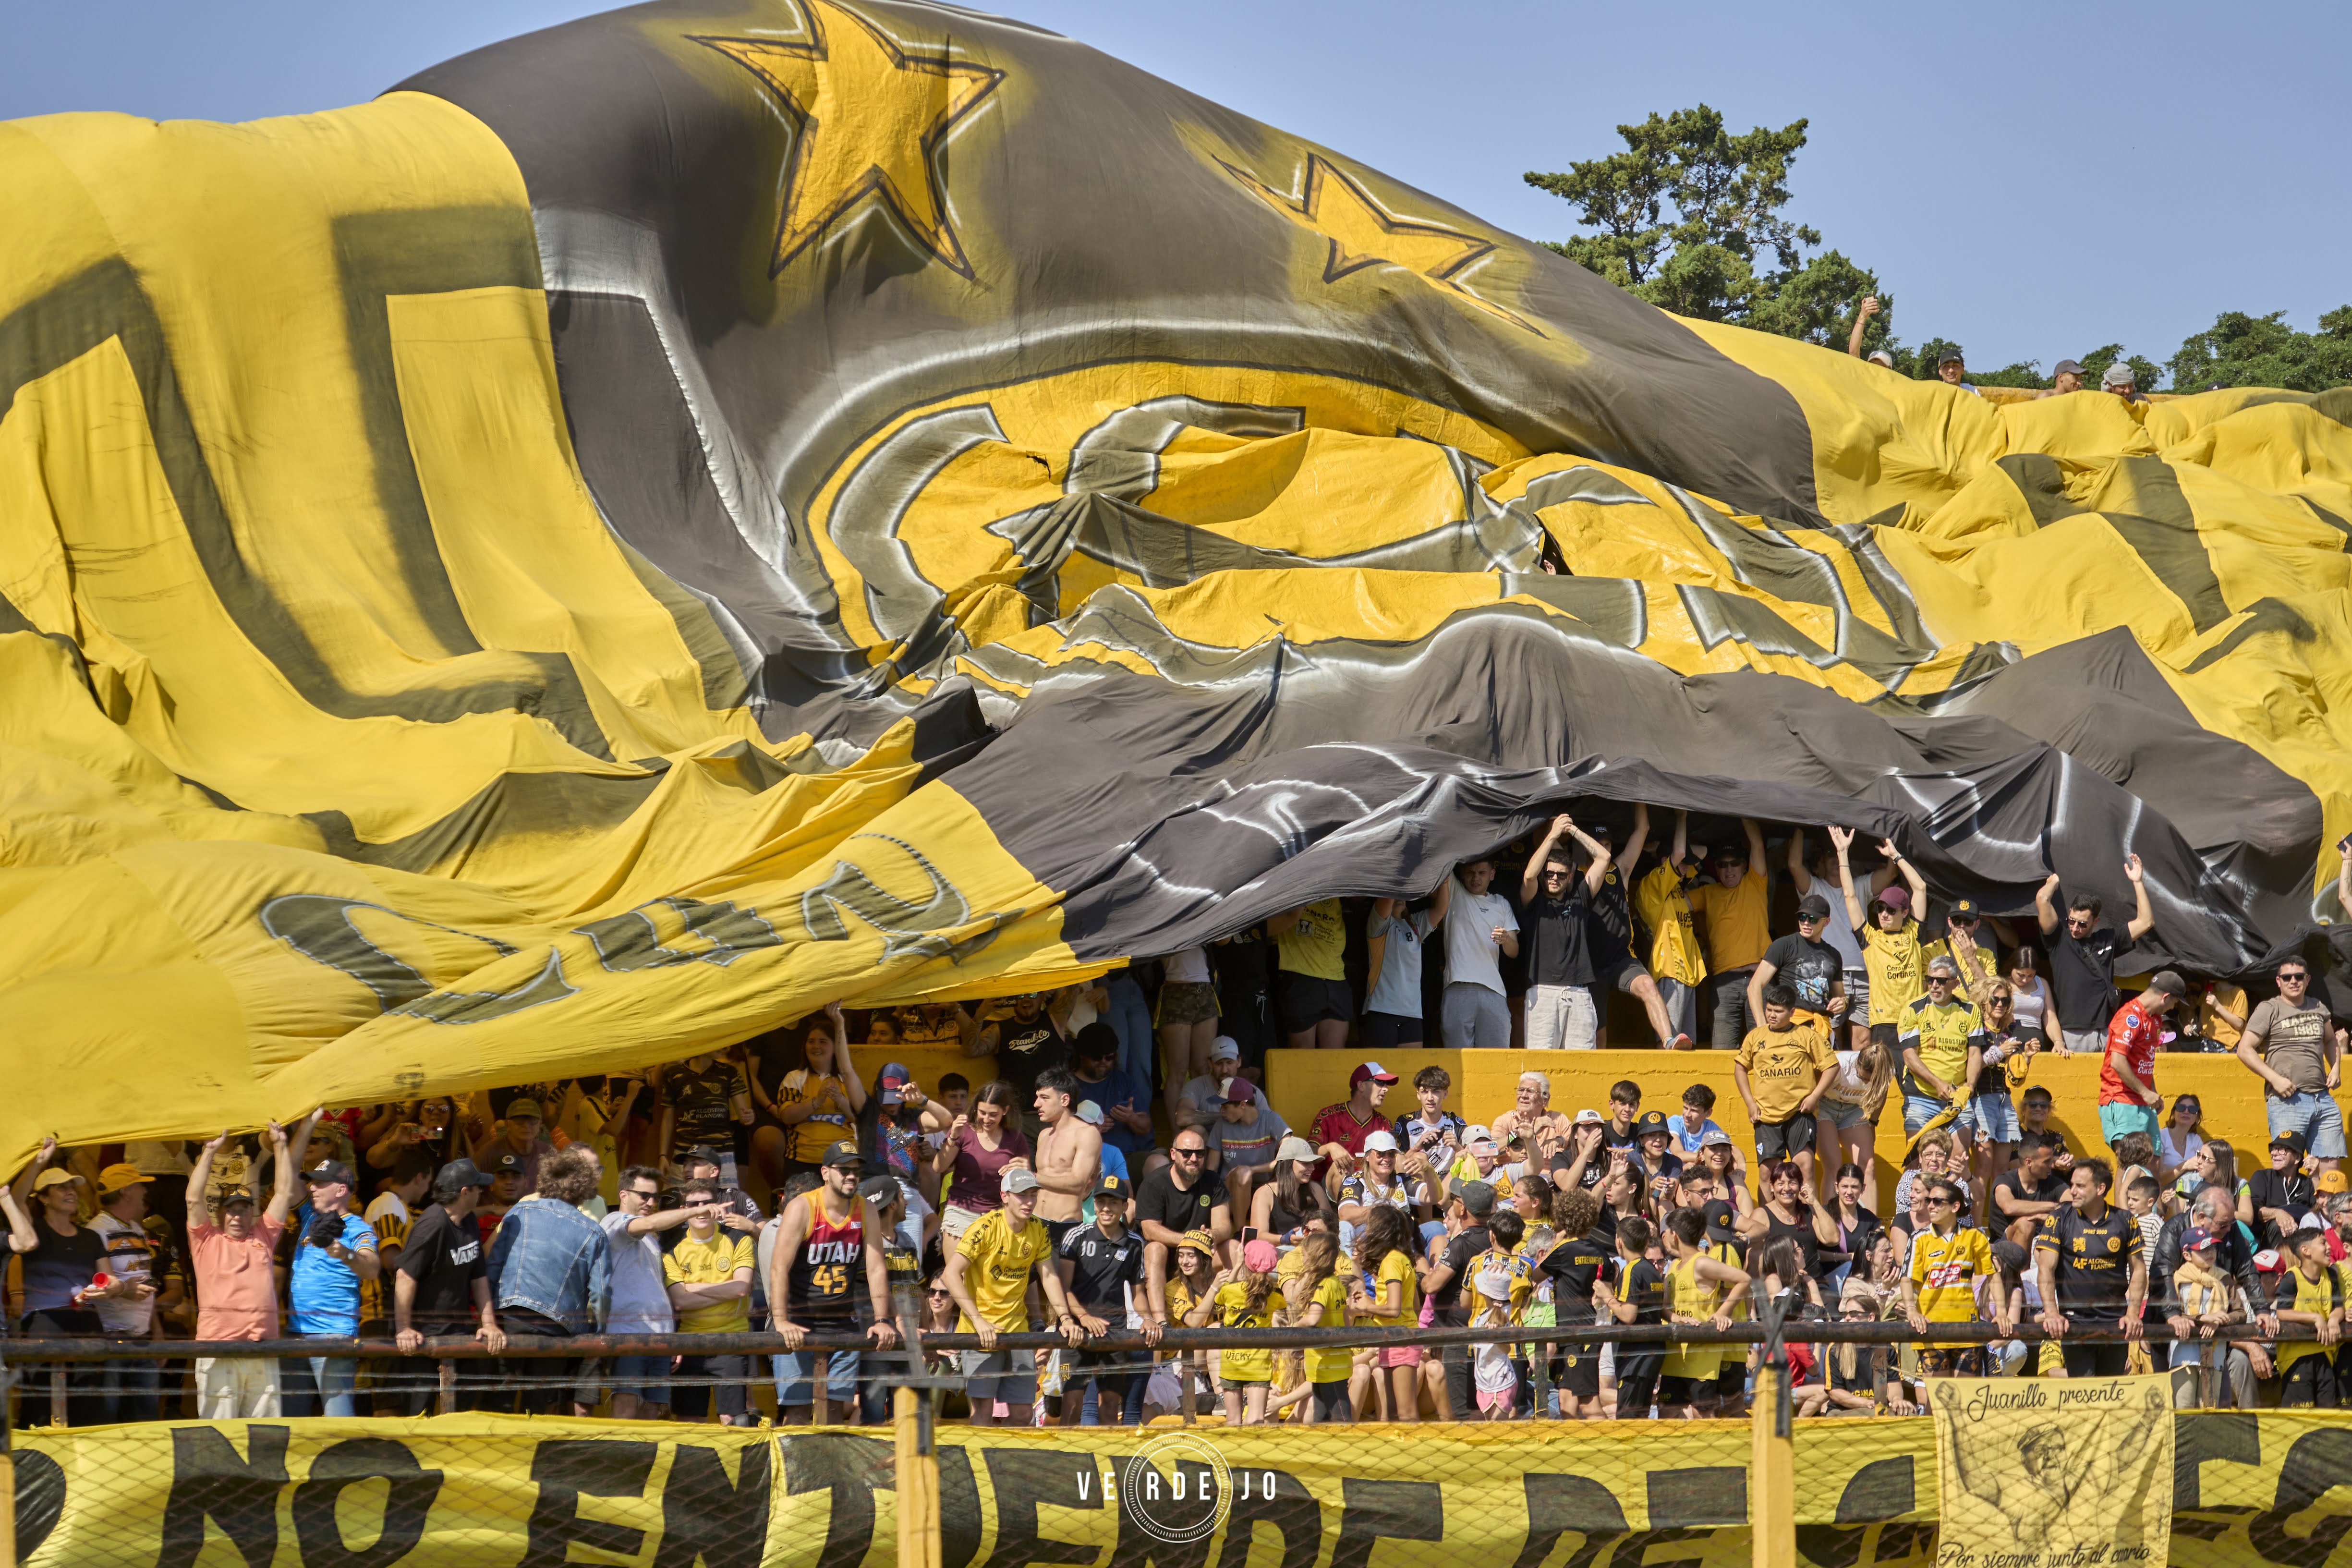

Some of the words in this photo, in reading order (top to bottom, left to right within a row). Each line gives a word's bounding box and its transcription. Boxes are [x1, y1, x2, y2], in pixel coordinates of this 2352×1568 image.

[1406, 932, 1413, 942] 8
[1887, 970, 1916, 979] Cortines
[1760, 1067, 1801, 1078] CANARIO
[449, 1240, 479, 1266] VANS
[807, 1241, 860, 1265] UTAH
[1081, 1240, 1097, 1257] 10
[812, 1265, 848, 1294] 45
[1226, 1350, 1250, 1361] VICKY
[1967, 1384, 2048, 1422] Juanillo
[2058, 1380, 2135, 1414] presente
[156, 1424, 444, 1568] NO
[1938, 1542, 1974, 1568] Por
[2047, 1543, 2086, 1568] junto
[2089, 1543, 2110, 1564] al
